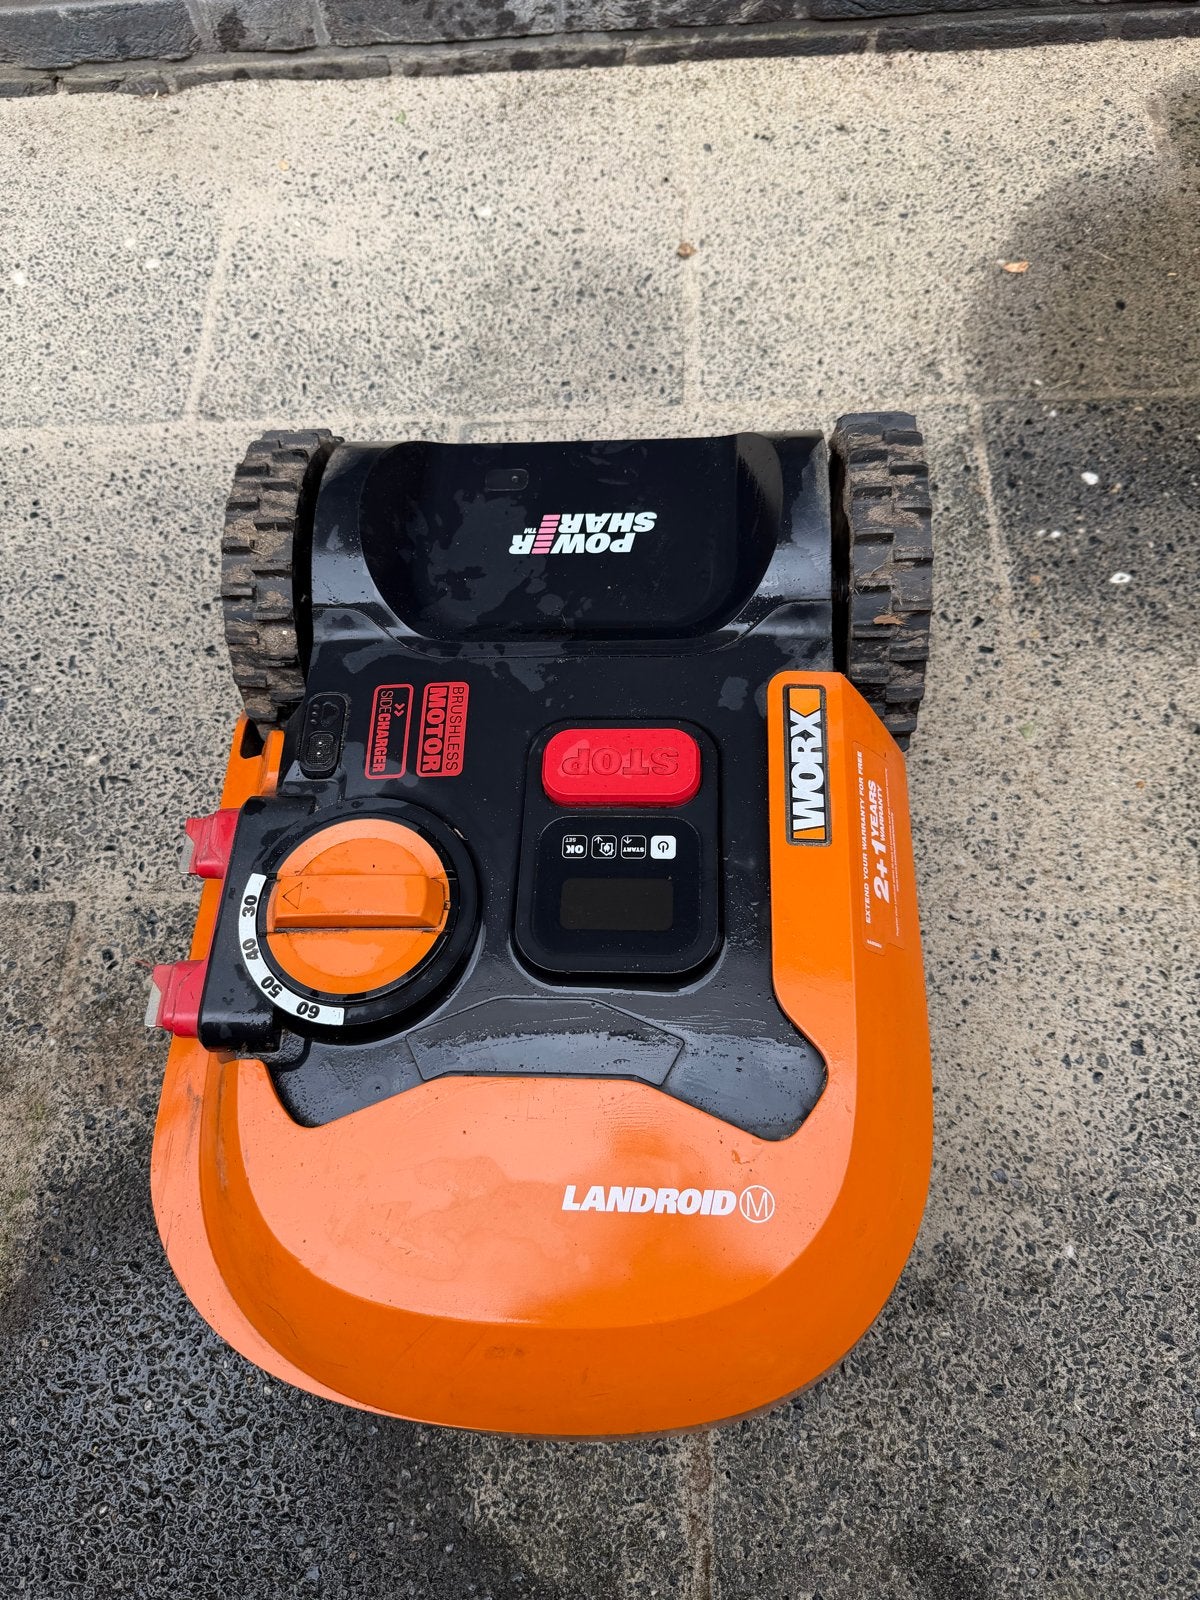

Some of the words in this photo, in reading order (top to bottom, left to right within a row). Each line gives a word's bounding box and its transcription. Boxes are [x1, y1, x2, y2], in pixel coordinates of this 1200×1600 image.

[372, 690, 393, 773] SIDECHARGER
[421, 687, 448, 772] MOTOR
[445, 686, 465, 771] BRUSHLESS
[561, 747, 680, 776] STOP
[790, 709, 825, 831] WORX
[856, 750, 864, 775] FREE
[859, 797, 868, 850] WARRANTY
[868, 779, 879, 837] YEARS
[876, 785, 886, 841] WARRANTY
[566, 844, 585, 854] OK
[242, 894, 258, 918] 30
[863, 882, 871, 924] EXTEND
[242, 938, 259, 961] 40
[260, 975, 283, 999] 50
[296, 1001, 320, 1019] 60
[561, 1184, 737, 1216] LANDROID
[742, 1187, 772, 1221] M
